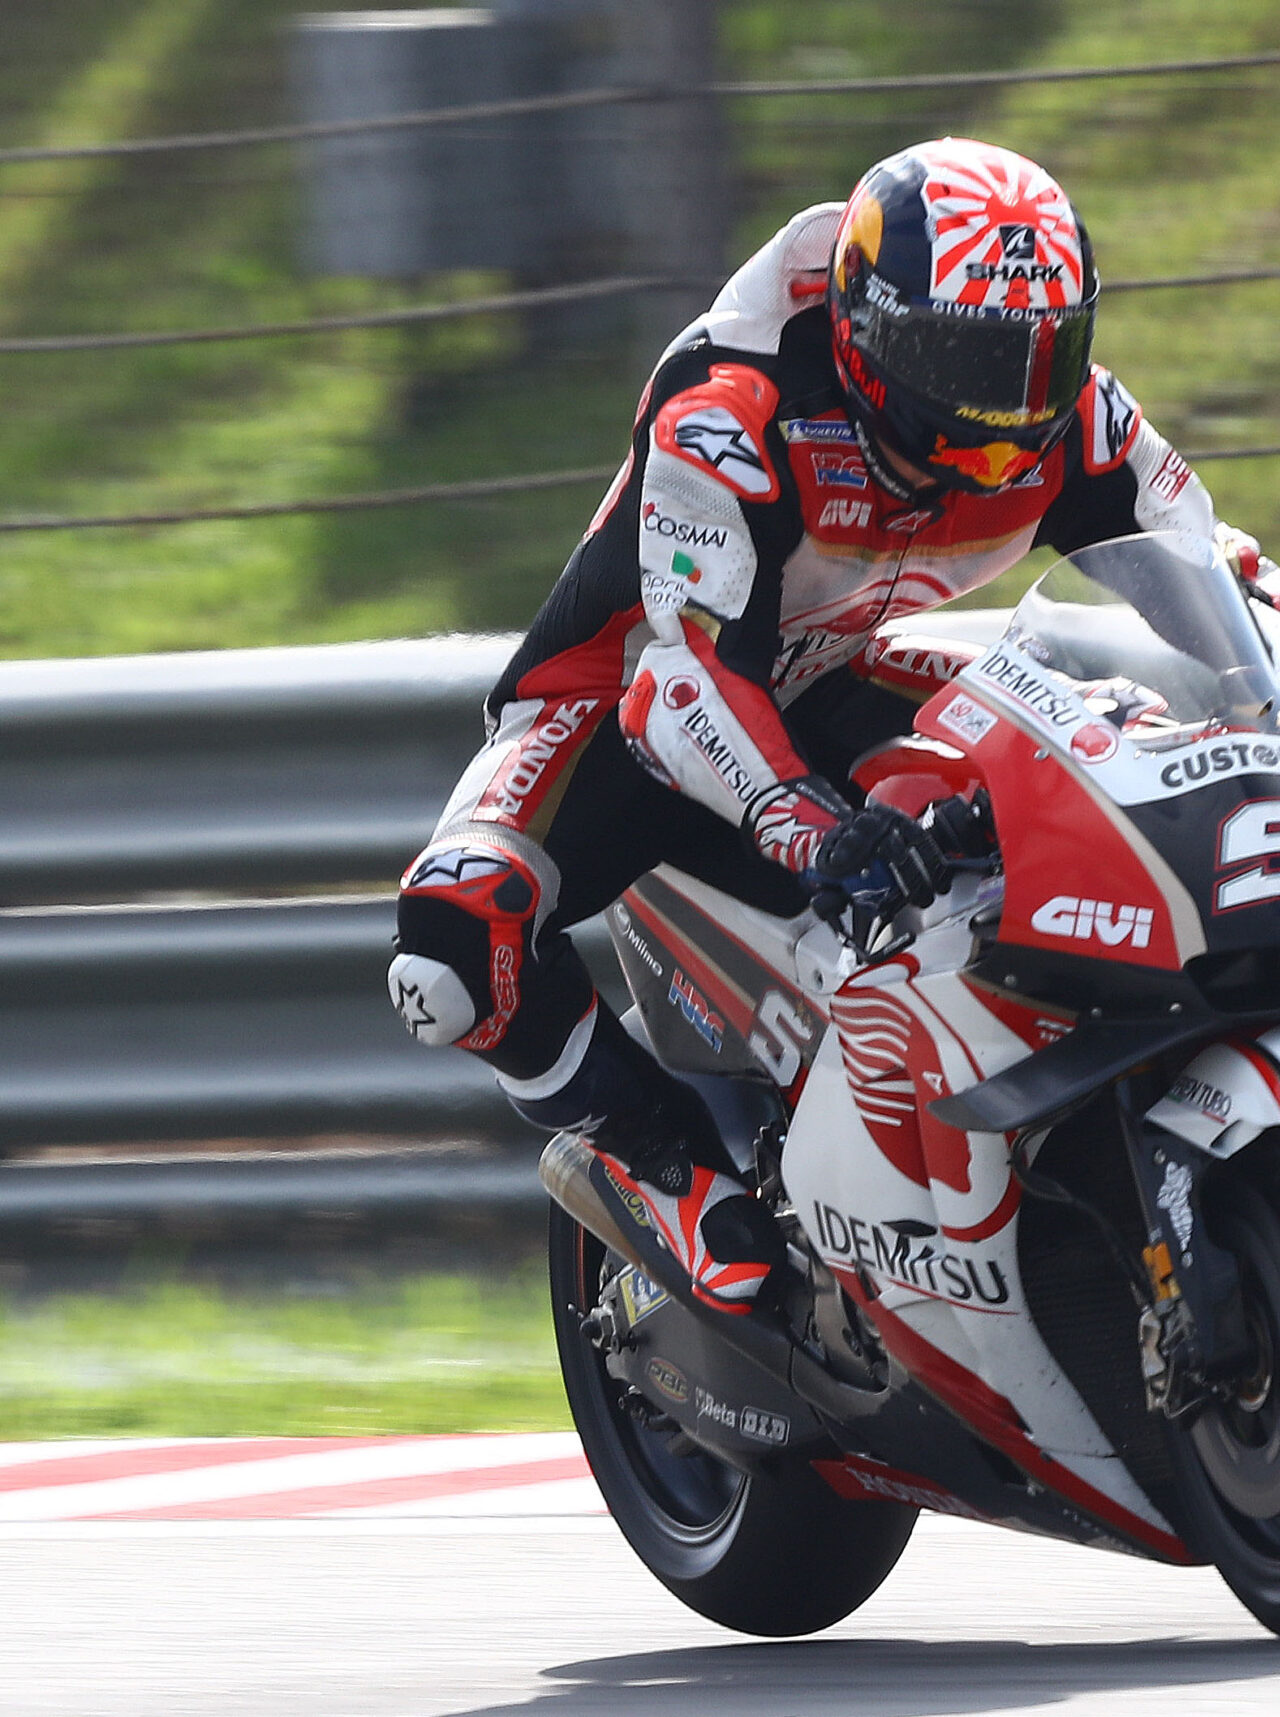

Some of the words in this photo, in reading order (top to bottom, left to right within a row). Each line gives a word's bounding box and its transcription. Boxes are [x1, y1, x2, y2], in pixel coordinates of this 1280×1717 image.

[932, 300, 986, 320] GIVES
[1001, 305, 1035, 323] YOU
[965, 263, 1064, 282] SHARK
[644, 511, 729, 549] COSMAI
[980, 652, 1082, 726] IDEMITSU
[496, 698, 600, 816] HONDA
[684, 706, 760, 803] IDEMITSU
[1031, 895, 1154, 949] GIVI
[668, 967, 726, 1055] HRC
[750, 987, 814, 1088] 5
[813, 1199, 1009, 1304] IDEMITSU
